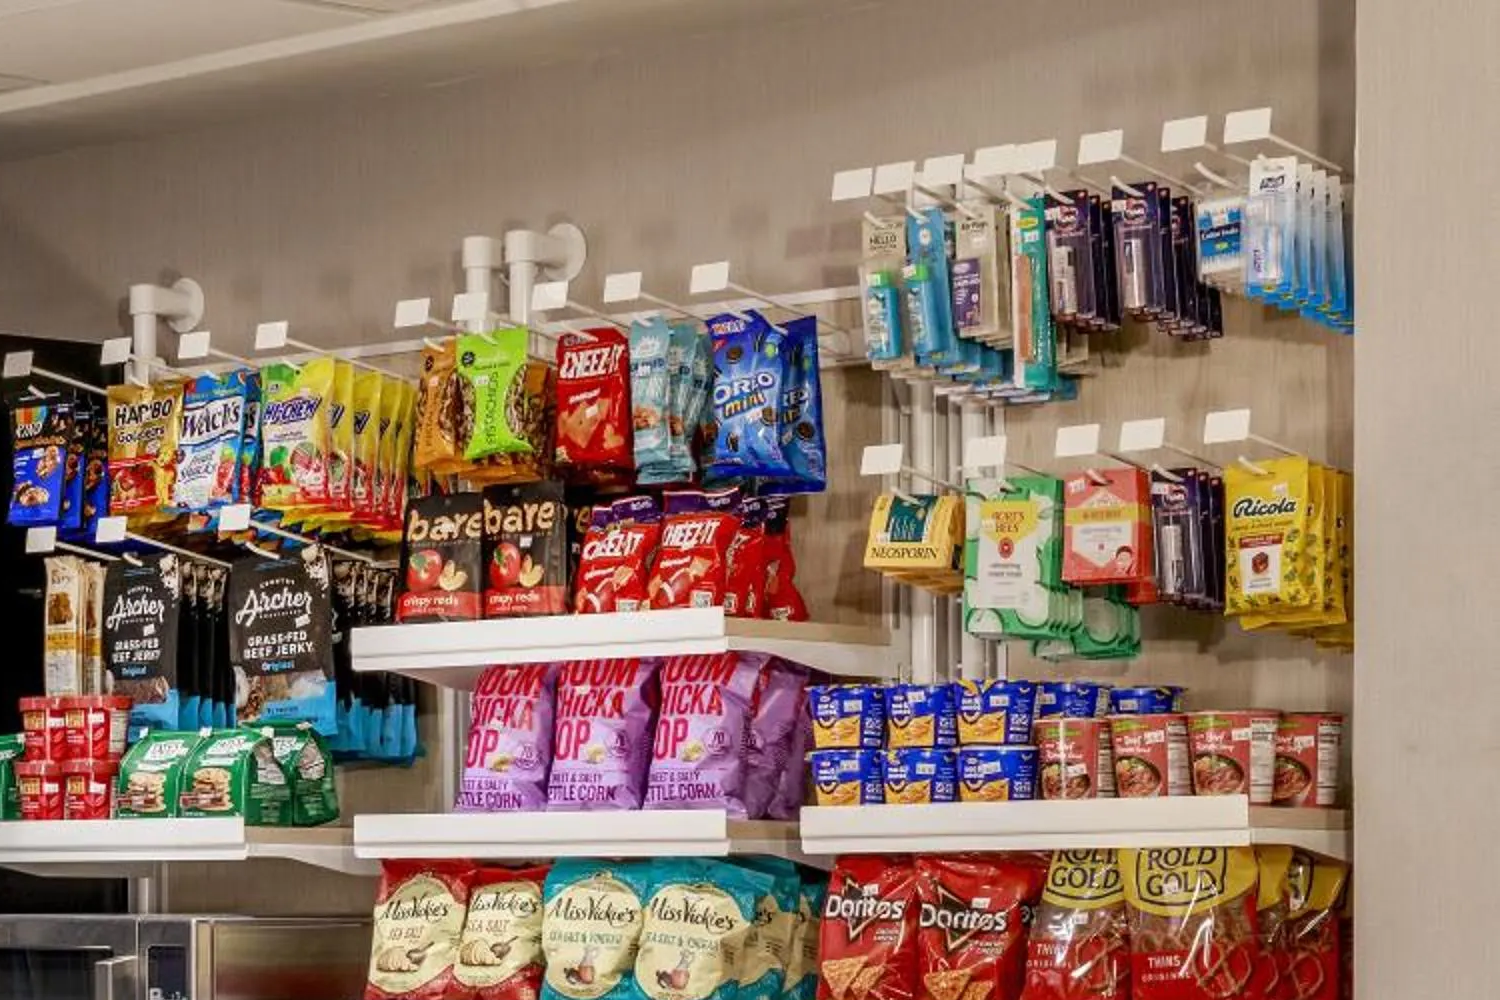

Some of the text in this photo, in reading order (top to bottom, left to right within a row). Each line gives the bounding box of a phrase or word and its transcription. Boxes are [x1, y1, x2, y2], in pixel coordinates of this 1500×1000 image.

[713, 371, 775, 406] OREO
[723, 392, 766, 419] mini
[484, 498, 555, 535] bare
[1233, 497, 1296, 519] Ricola
[407, 510, 482, 542] bare
[870, 547, 940, 560] NEOSPORIN
[106, 594, 166, 632] Archer
[235, 587, 314, 628] Archer
[275, 641, 314, 657] JERKY
[555, 719, 591, 761] OP
[655, 718, 689, 760] OP
[1149, 847, 1218, 871] ROLD
[1051, 866, 1121, 889] GOLD
[1146, 869, 1218, 897] GOLD
[825, 894, 906, 920] Doritos
[919, 903, 1009, 931] Doritos
